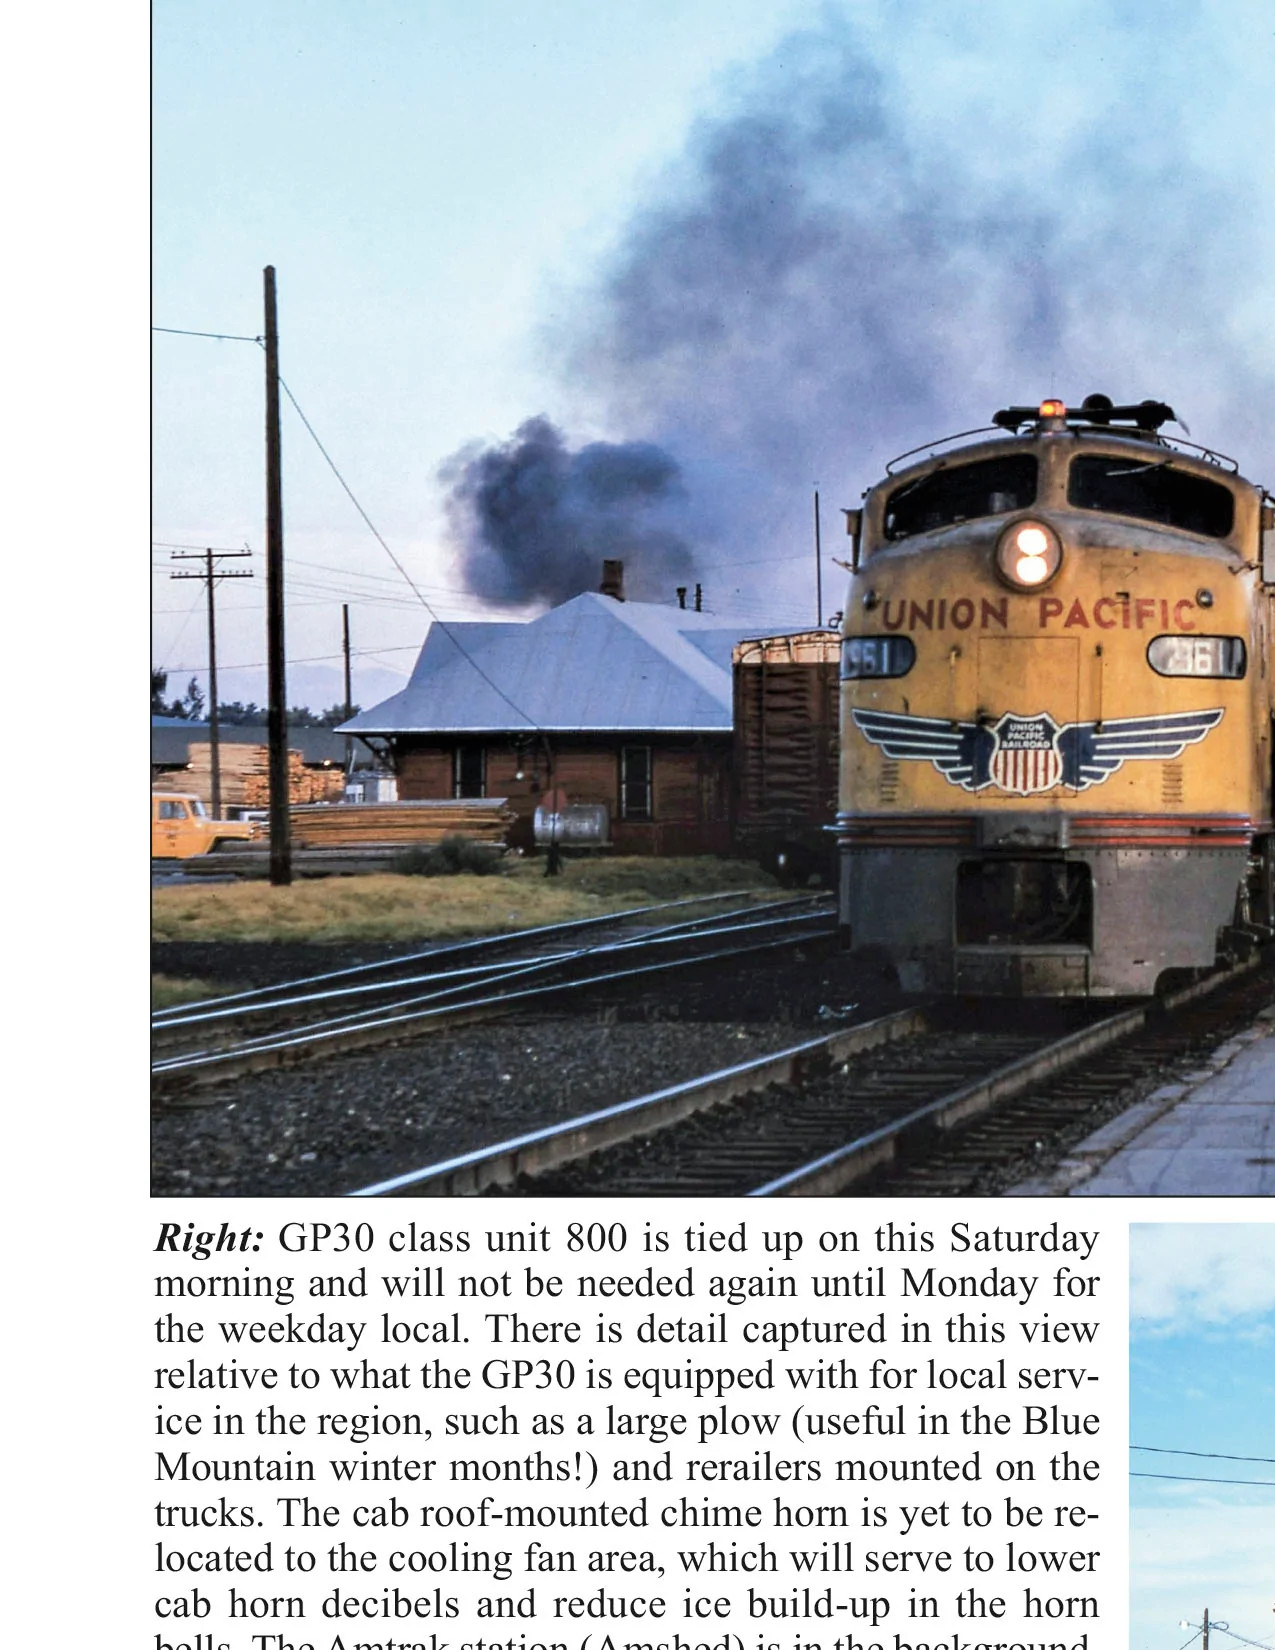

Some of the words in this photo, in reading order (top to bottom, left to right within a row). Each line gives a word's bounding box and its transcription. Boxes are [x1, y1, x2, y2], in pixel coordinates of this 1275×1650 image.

[883, 598, 1008, 632] UNION
[1038, 597, 1196, 632] PACIFIC
[1010, 723, 1044, 732] UNION
[1007, 731, 1046, 741] PACIFIC
[1001, 740, 1051, 749] RAILROAD
